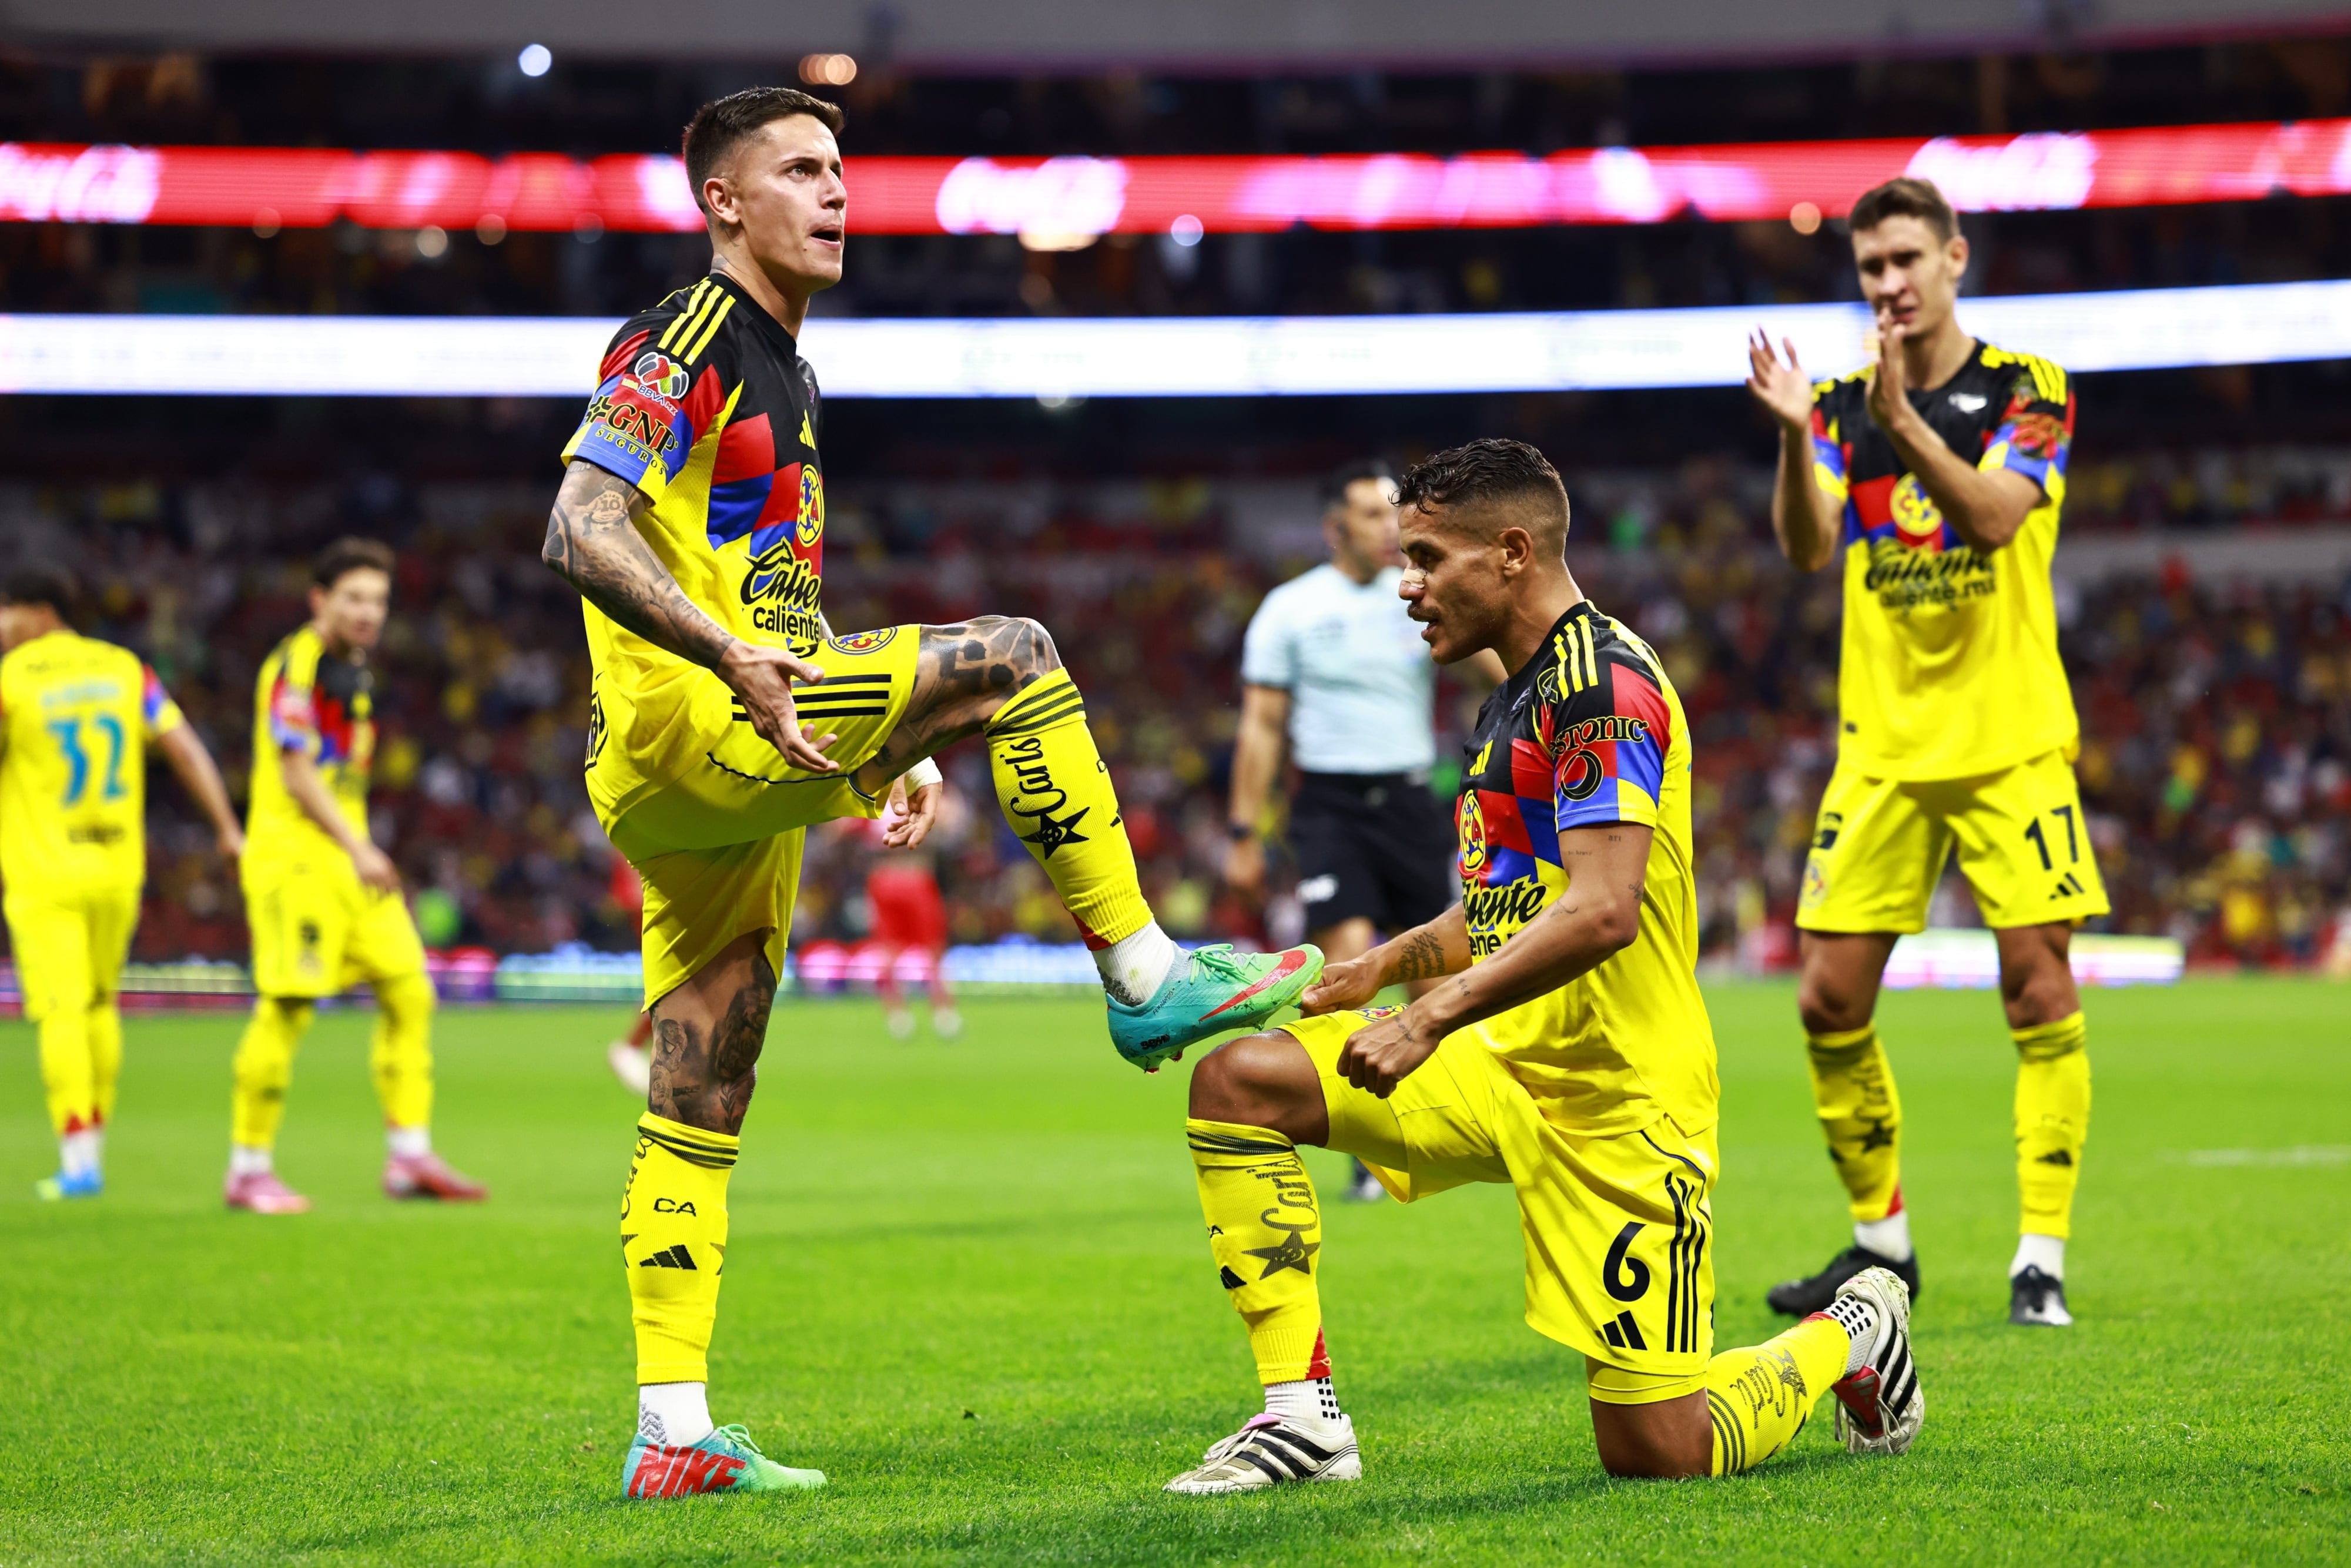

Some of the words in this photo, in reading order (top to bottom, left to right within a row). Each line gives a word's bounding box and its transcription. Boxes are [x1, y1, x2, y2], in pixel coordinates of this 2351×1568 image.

[638, 386, 664, 405] BBVA
[597, 429, 665, 475] SEGUROS
[608, 404, 675, 457] GNP
[2025, 804, 2079, 871] 17
[654, 1198, 696, 1217] CA
[1603, 1221, 1650, 1302] 6
[628, 1444, 746, 1499] NIKE
